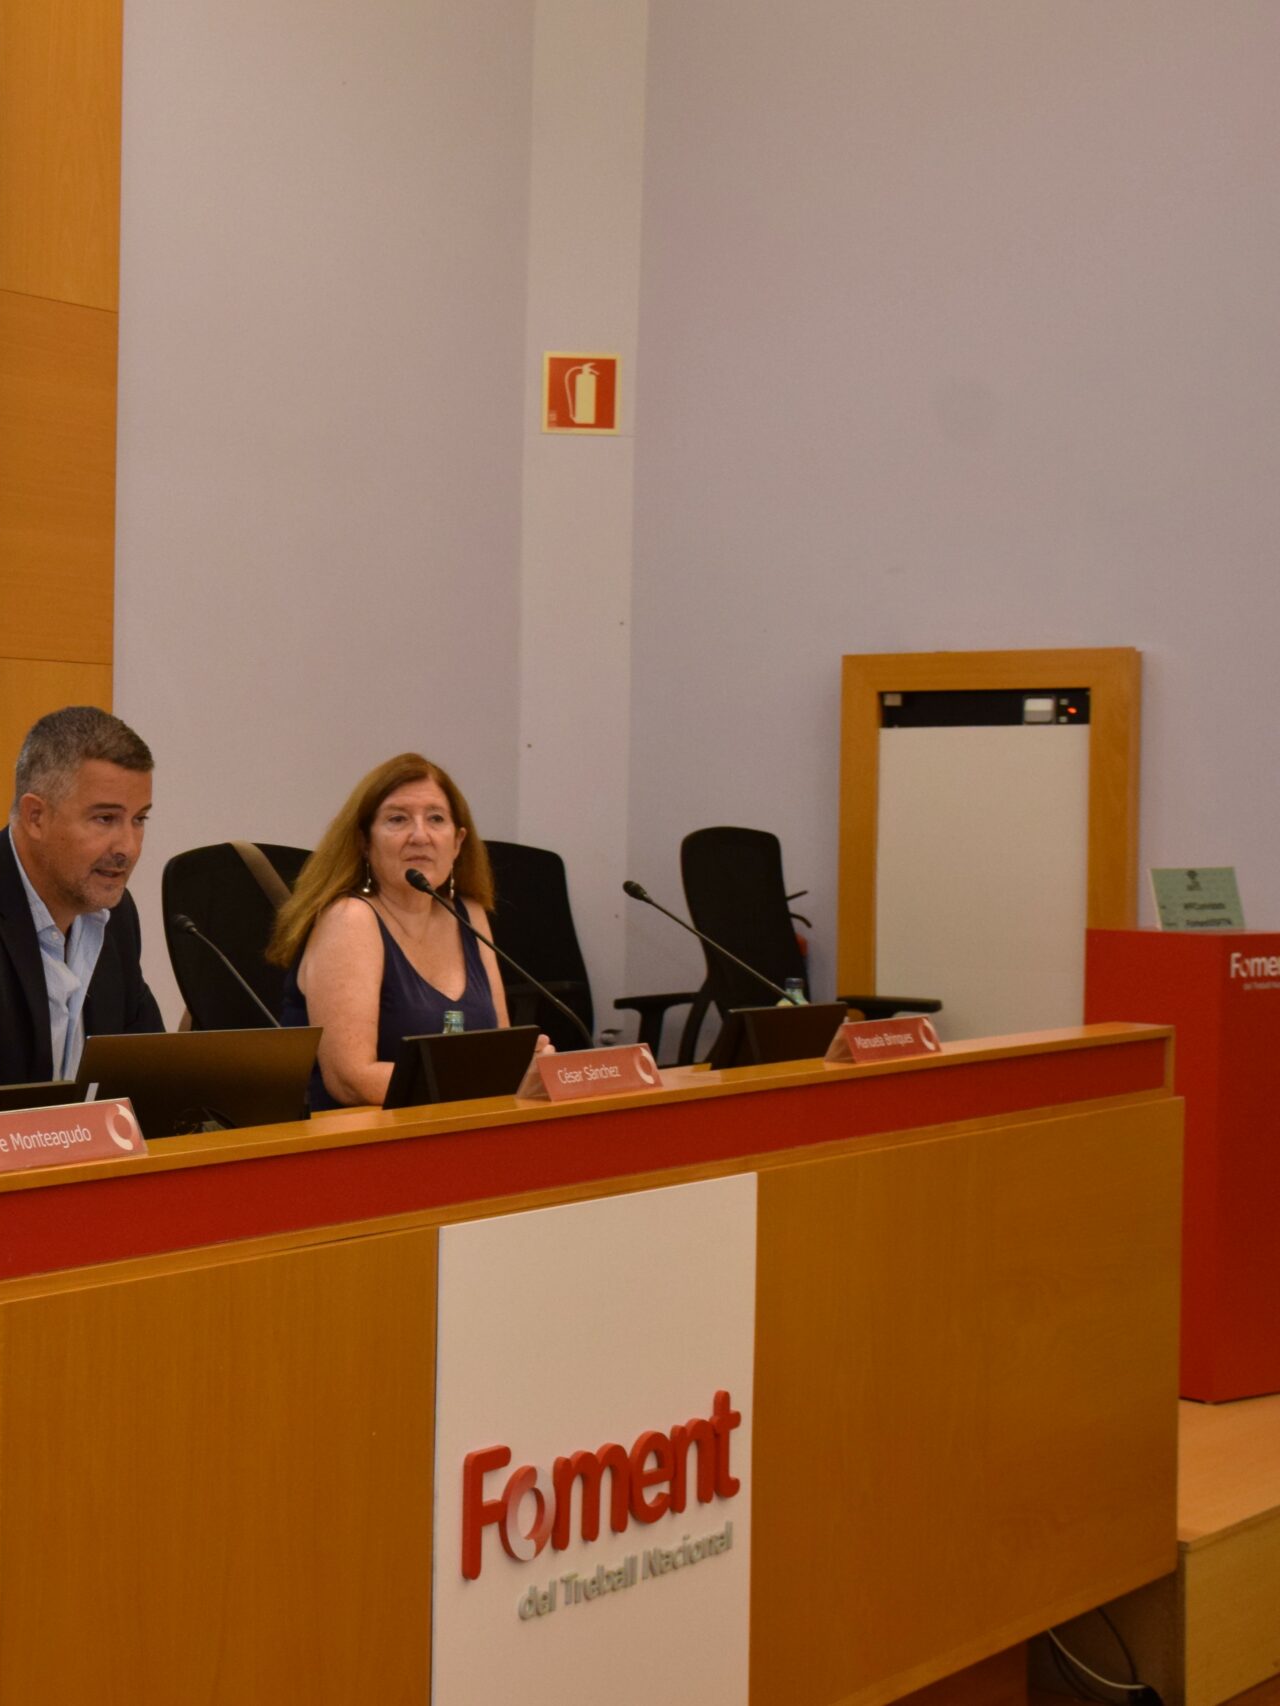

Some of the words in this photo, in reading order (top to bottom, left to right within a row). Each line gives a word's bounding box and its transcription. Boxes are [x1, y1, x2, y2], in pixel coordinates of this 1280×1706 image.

[1230, 952, 1280, 979] Fome
[557, 1066, 585, 1084] César
[583, 1063, 622, 1081] Sánchez
[9, 1123, 93, 1151] Monteagudo
[460, 1389, 742, 1581] Foment
[518, 1578, 558, 1621] del
[559, 1554, 639, 1607] Treball
[641, 1520, 734, 1581] Nacional
